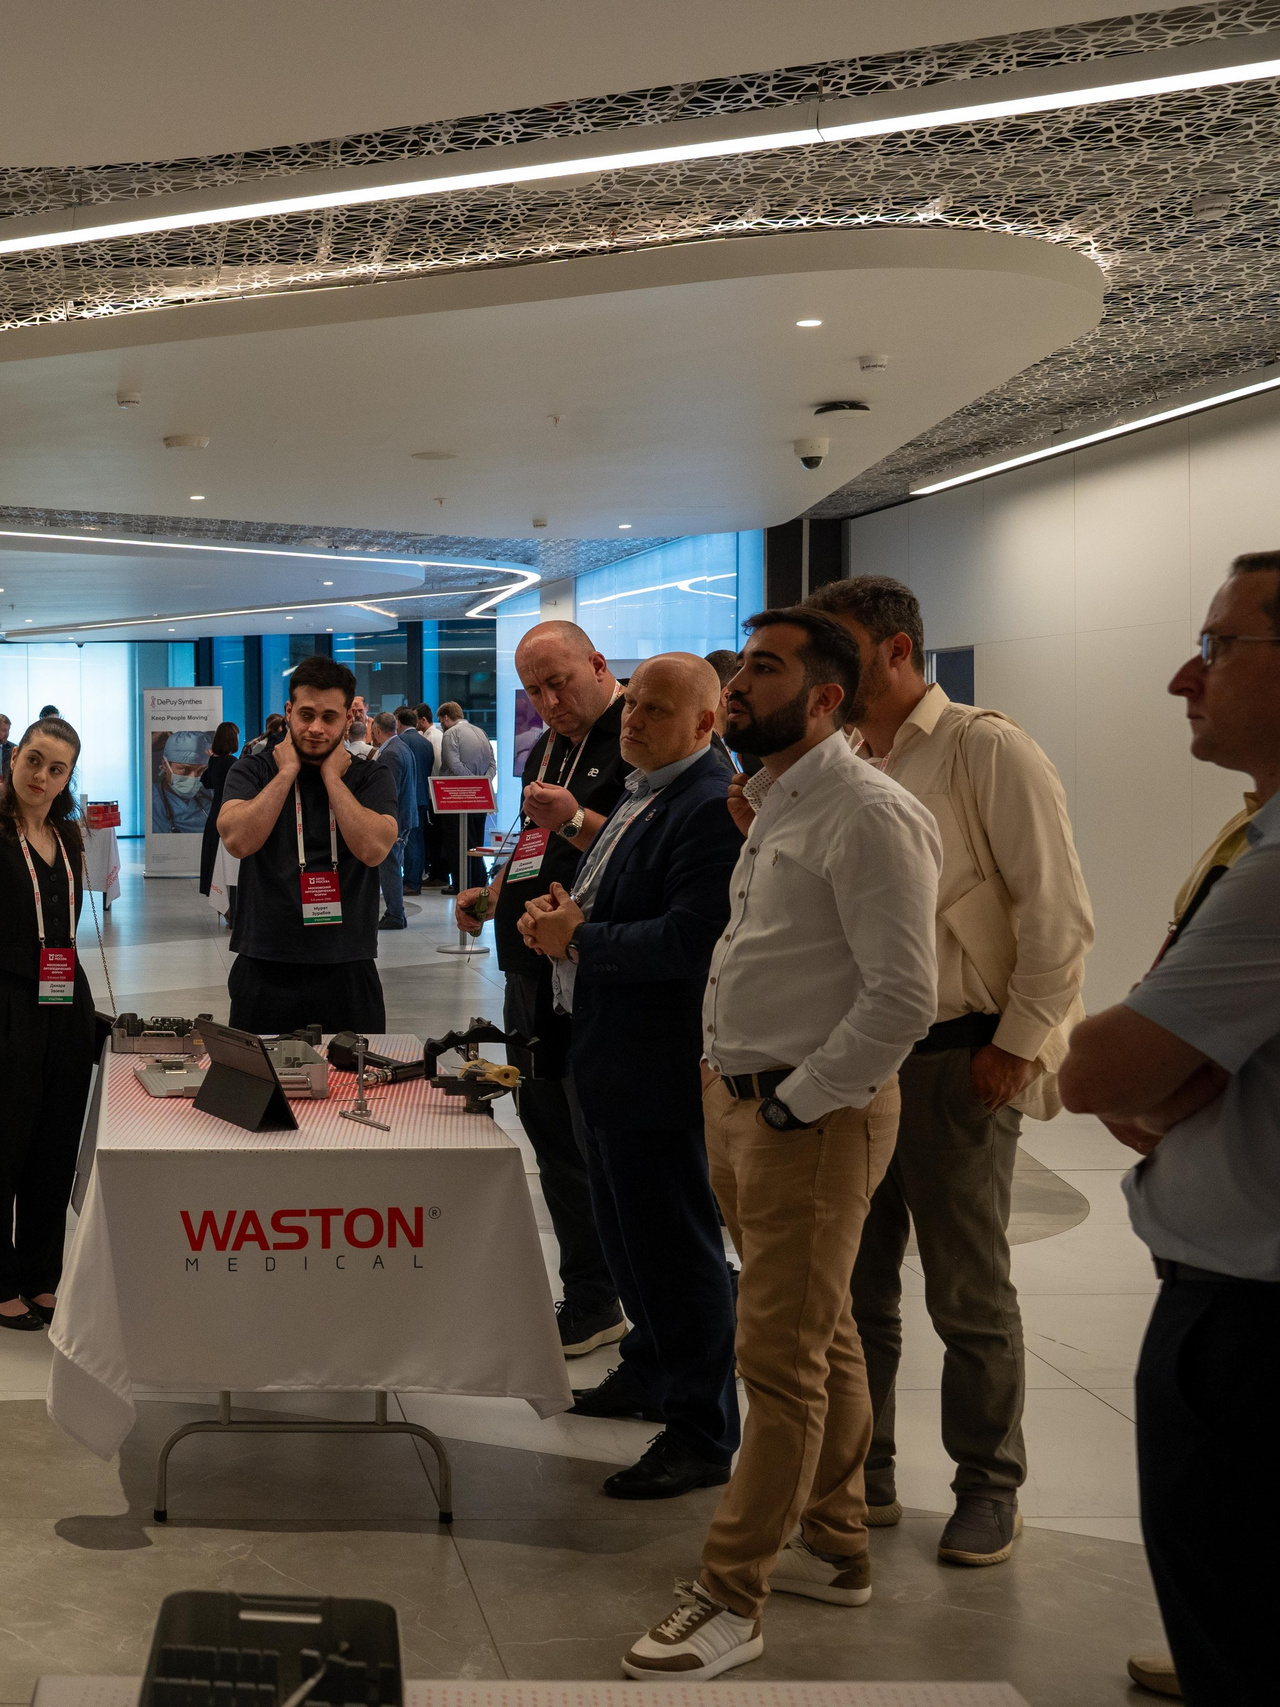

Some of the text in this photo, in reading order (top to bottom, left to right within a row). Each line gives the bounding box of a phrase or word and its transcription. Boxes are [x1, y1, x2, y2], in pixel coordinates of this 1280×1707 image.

[157, 698, 202, 706] DePuy Synthes
[186, 1255, 423, 1272] MEDICAL
